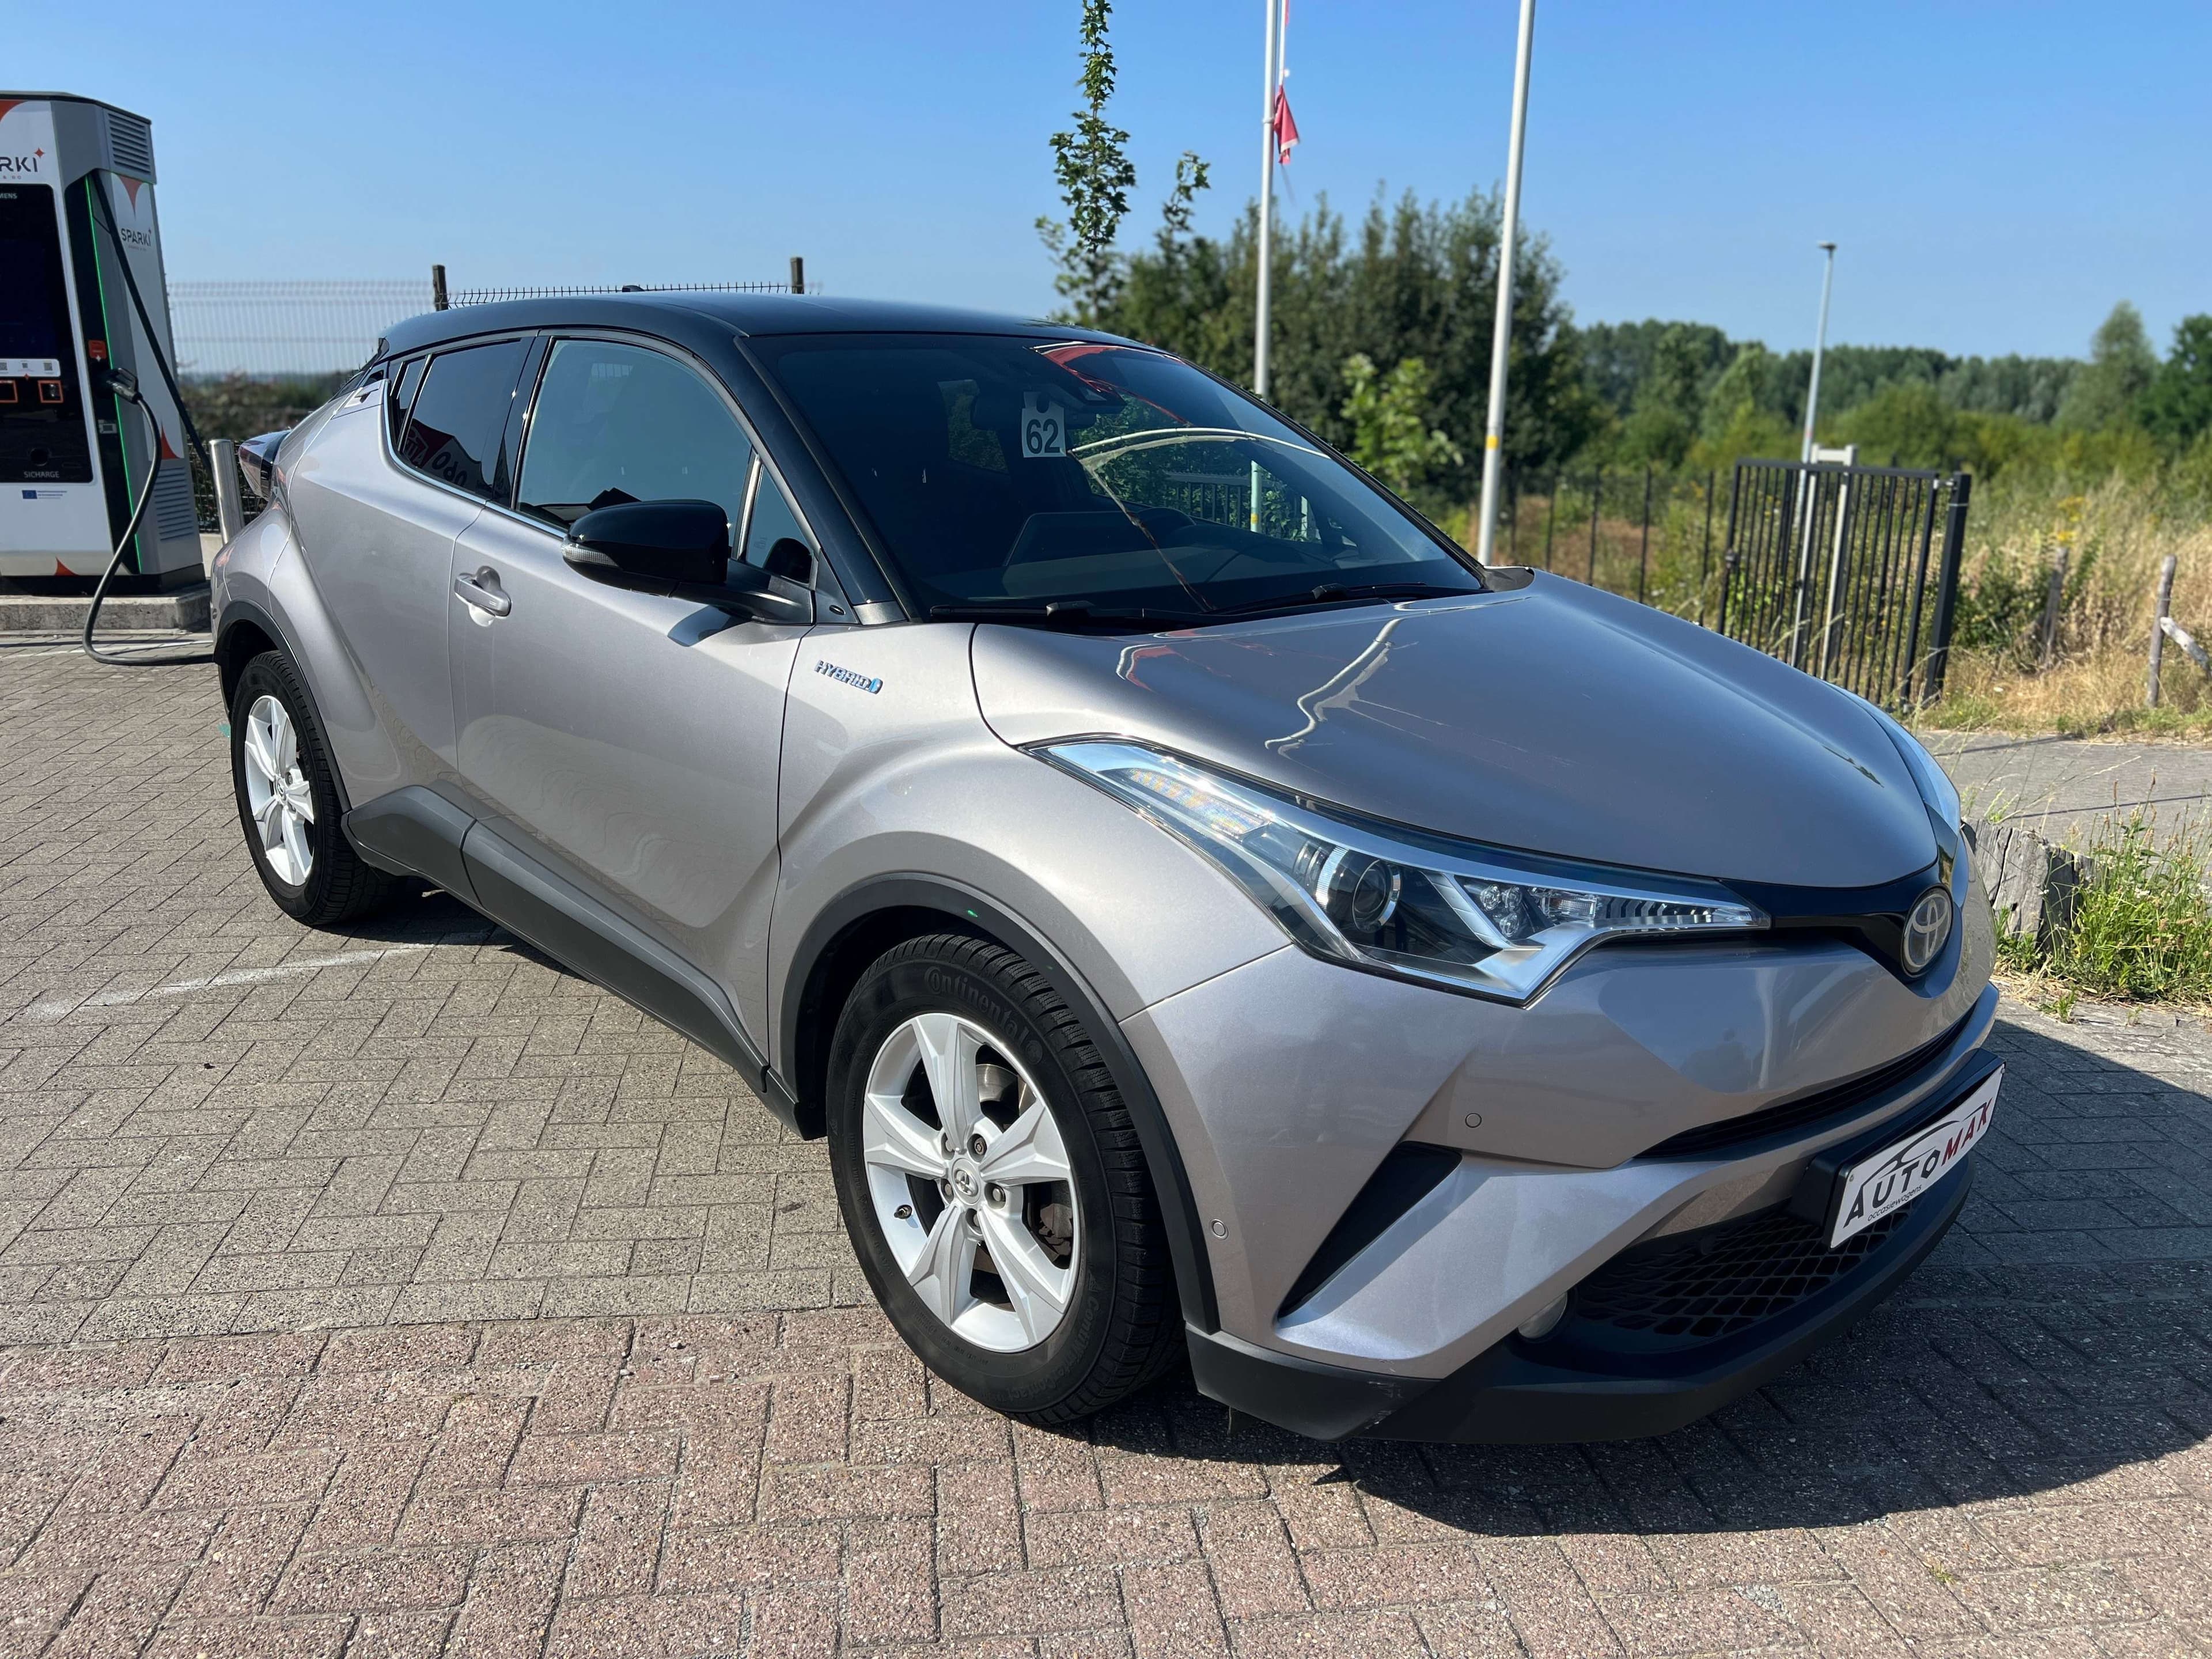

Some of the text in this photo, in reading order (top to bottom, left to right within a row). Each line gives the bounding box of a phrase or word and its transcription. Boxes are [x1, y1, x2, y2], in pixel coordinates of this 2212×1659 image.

[121, 228, 151, 247] SPARKI
[1026, 418, 1060, 454] 62
[815, 659, 873, 692] HYBRID
[924, 966, 1030, 1050] Continental
[1843, 1097, 1993, 1229] AUTOMAX
